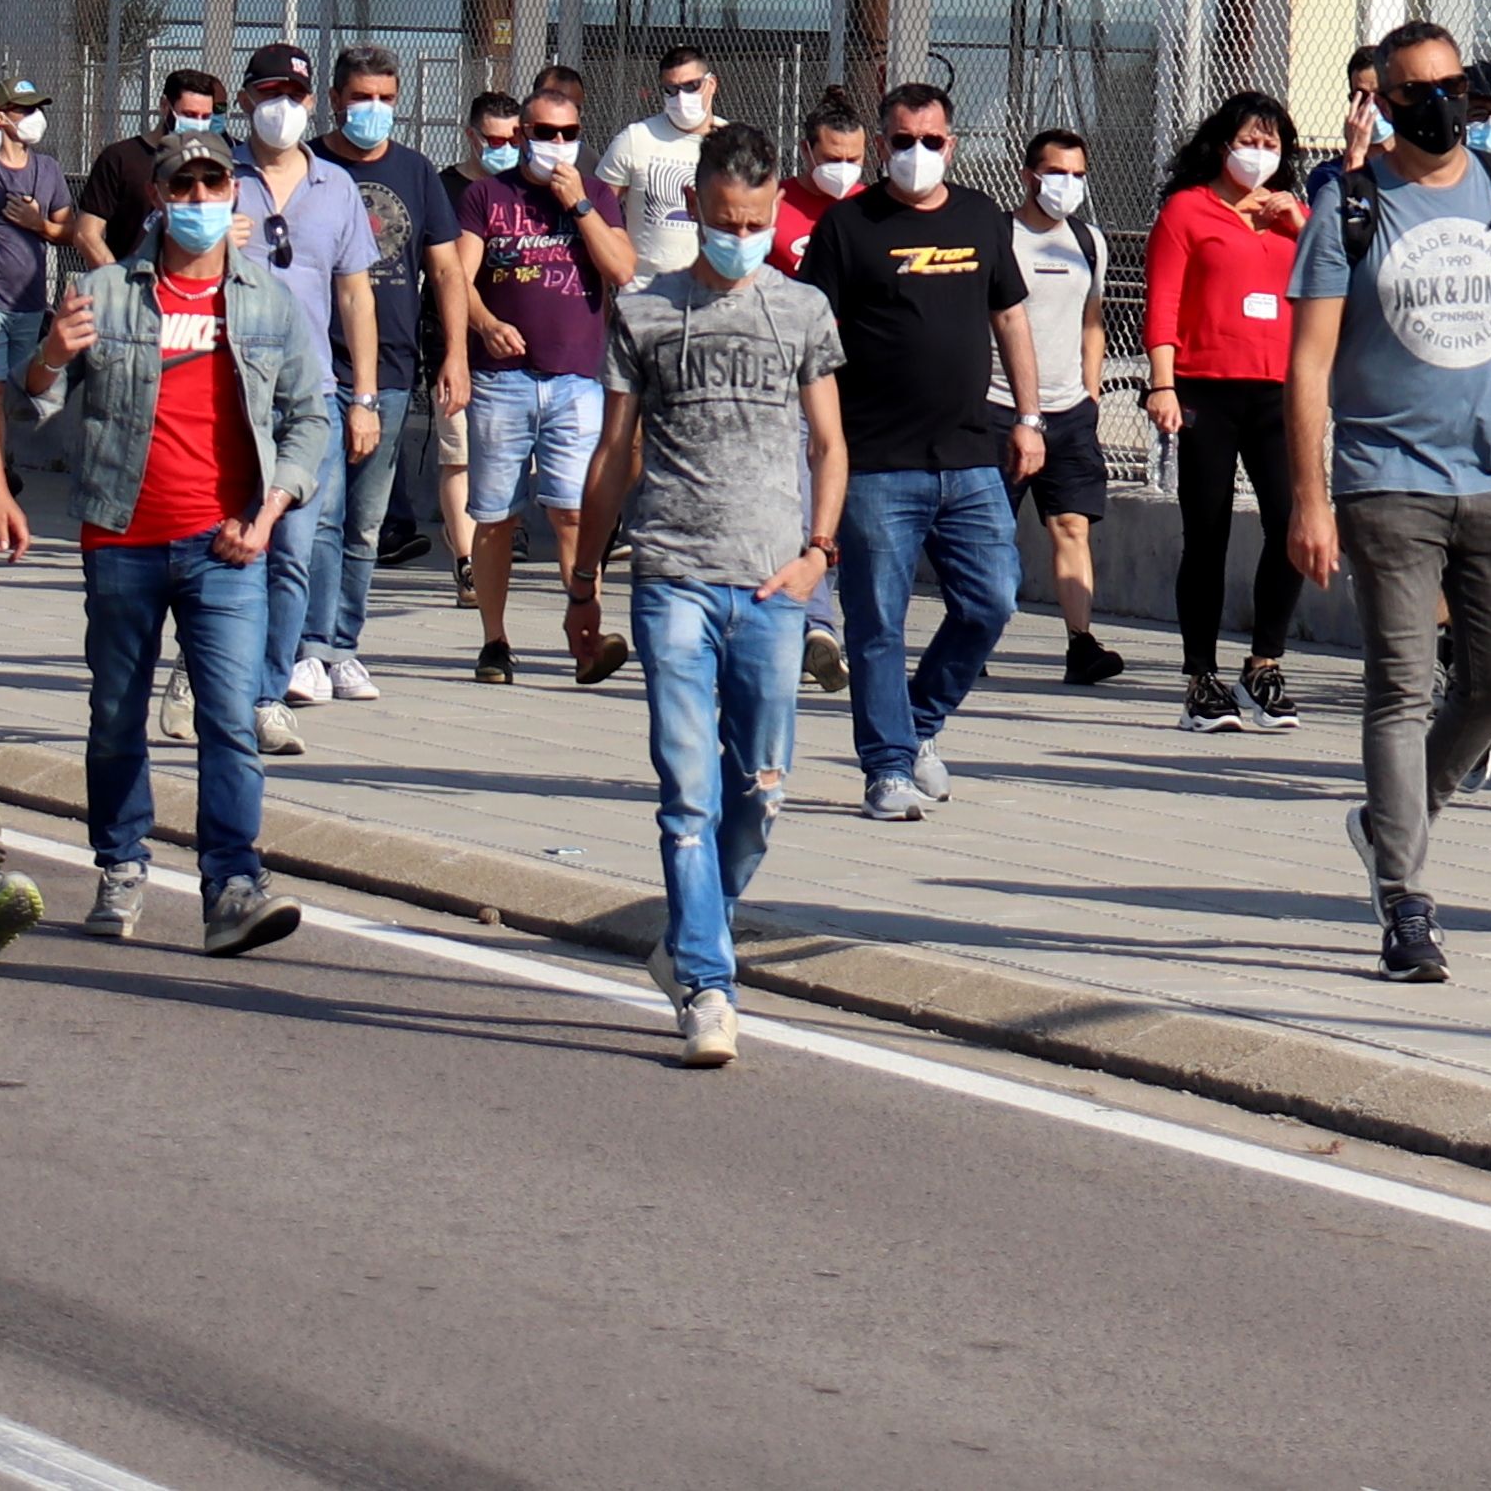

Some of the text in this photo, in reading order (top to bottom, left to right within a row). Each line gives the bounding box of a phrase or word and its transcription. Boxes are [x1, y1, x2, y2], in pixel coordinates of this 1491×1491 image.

[1401, 233, 1451, 272] TRADE
[1439, 255, 1472, 266] 1990
[160, 313, 226, 351] NIKE
[676, 345, 777, 392] INSIDE
